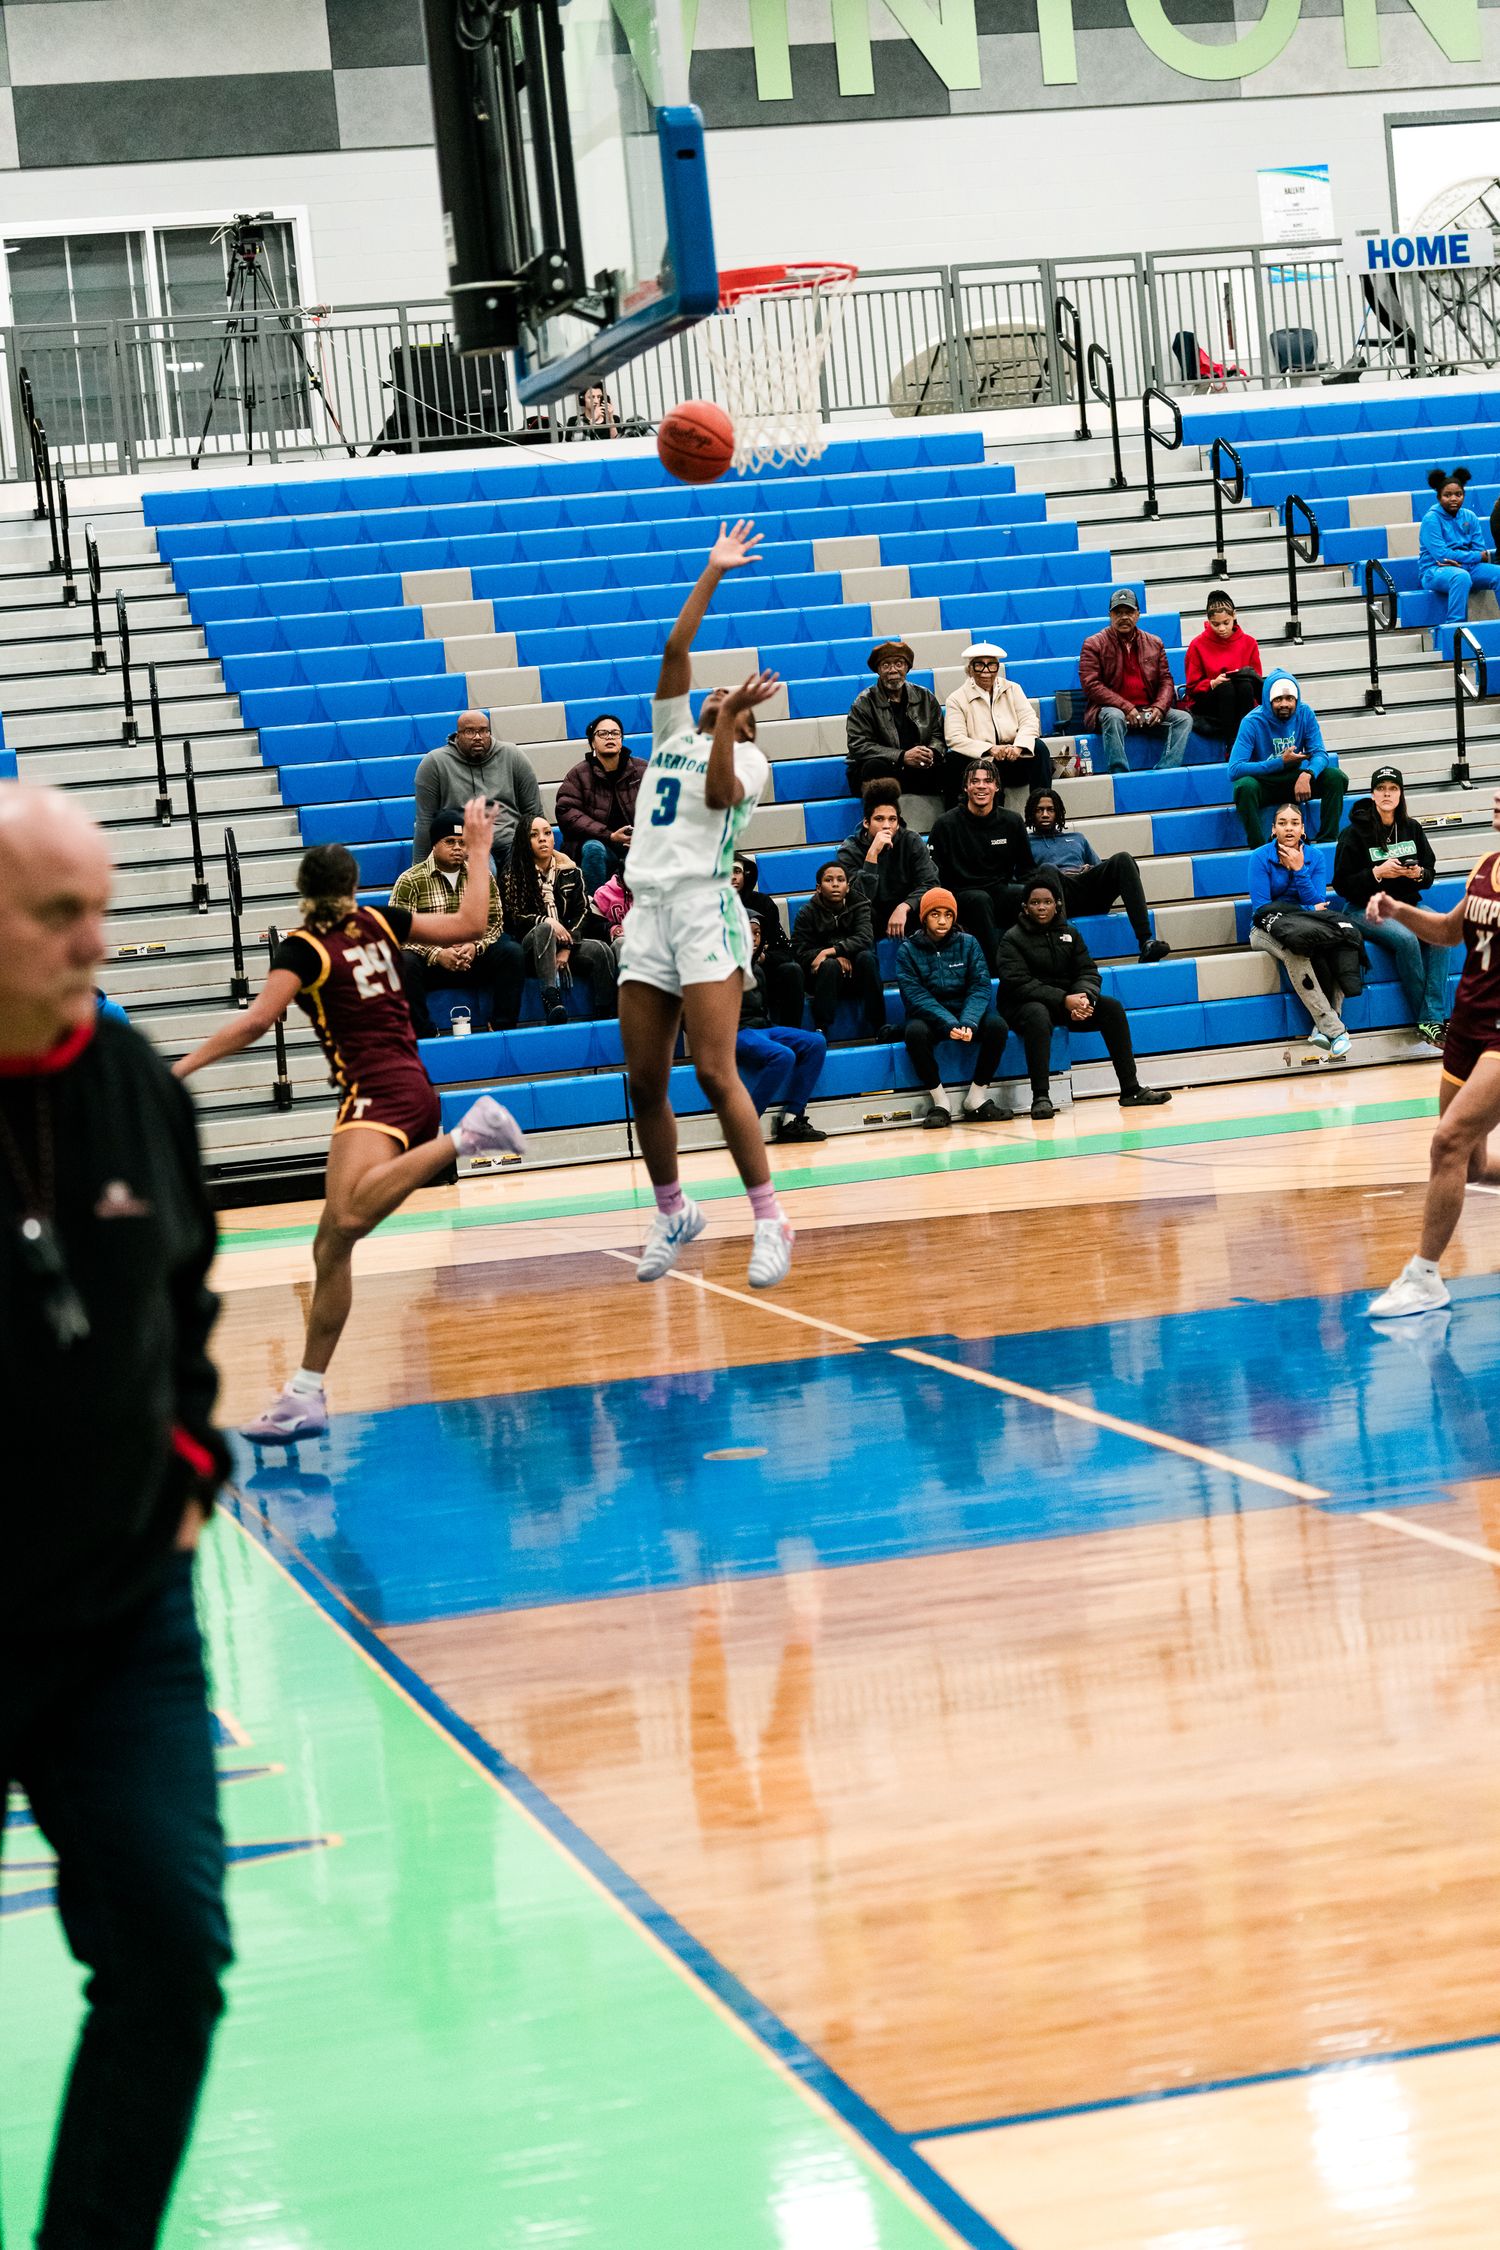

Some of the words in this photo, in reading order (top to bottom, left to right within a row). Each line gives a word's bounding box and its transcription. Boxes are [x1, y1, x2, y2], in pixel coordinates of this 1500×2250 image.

[1367, 234, 1471, 269] HOME
[651, 777, 682, 826] 3
[1464, 895, 1500, 928] TURP
[342, 939, 401, 1000] 24
[352, 1098, 373, 1119] T
